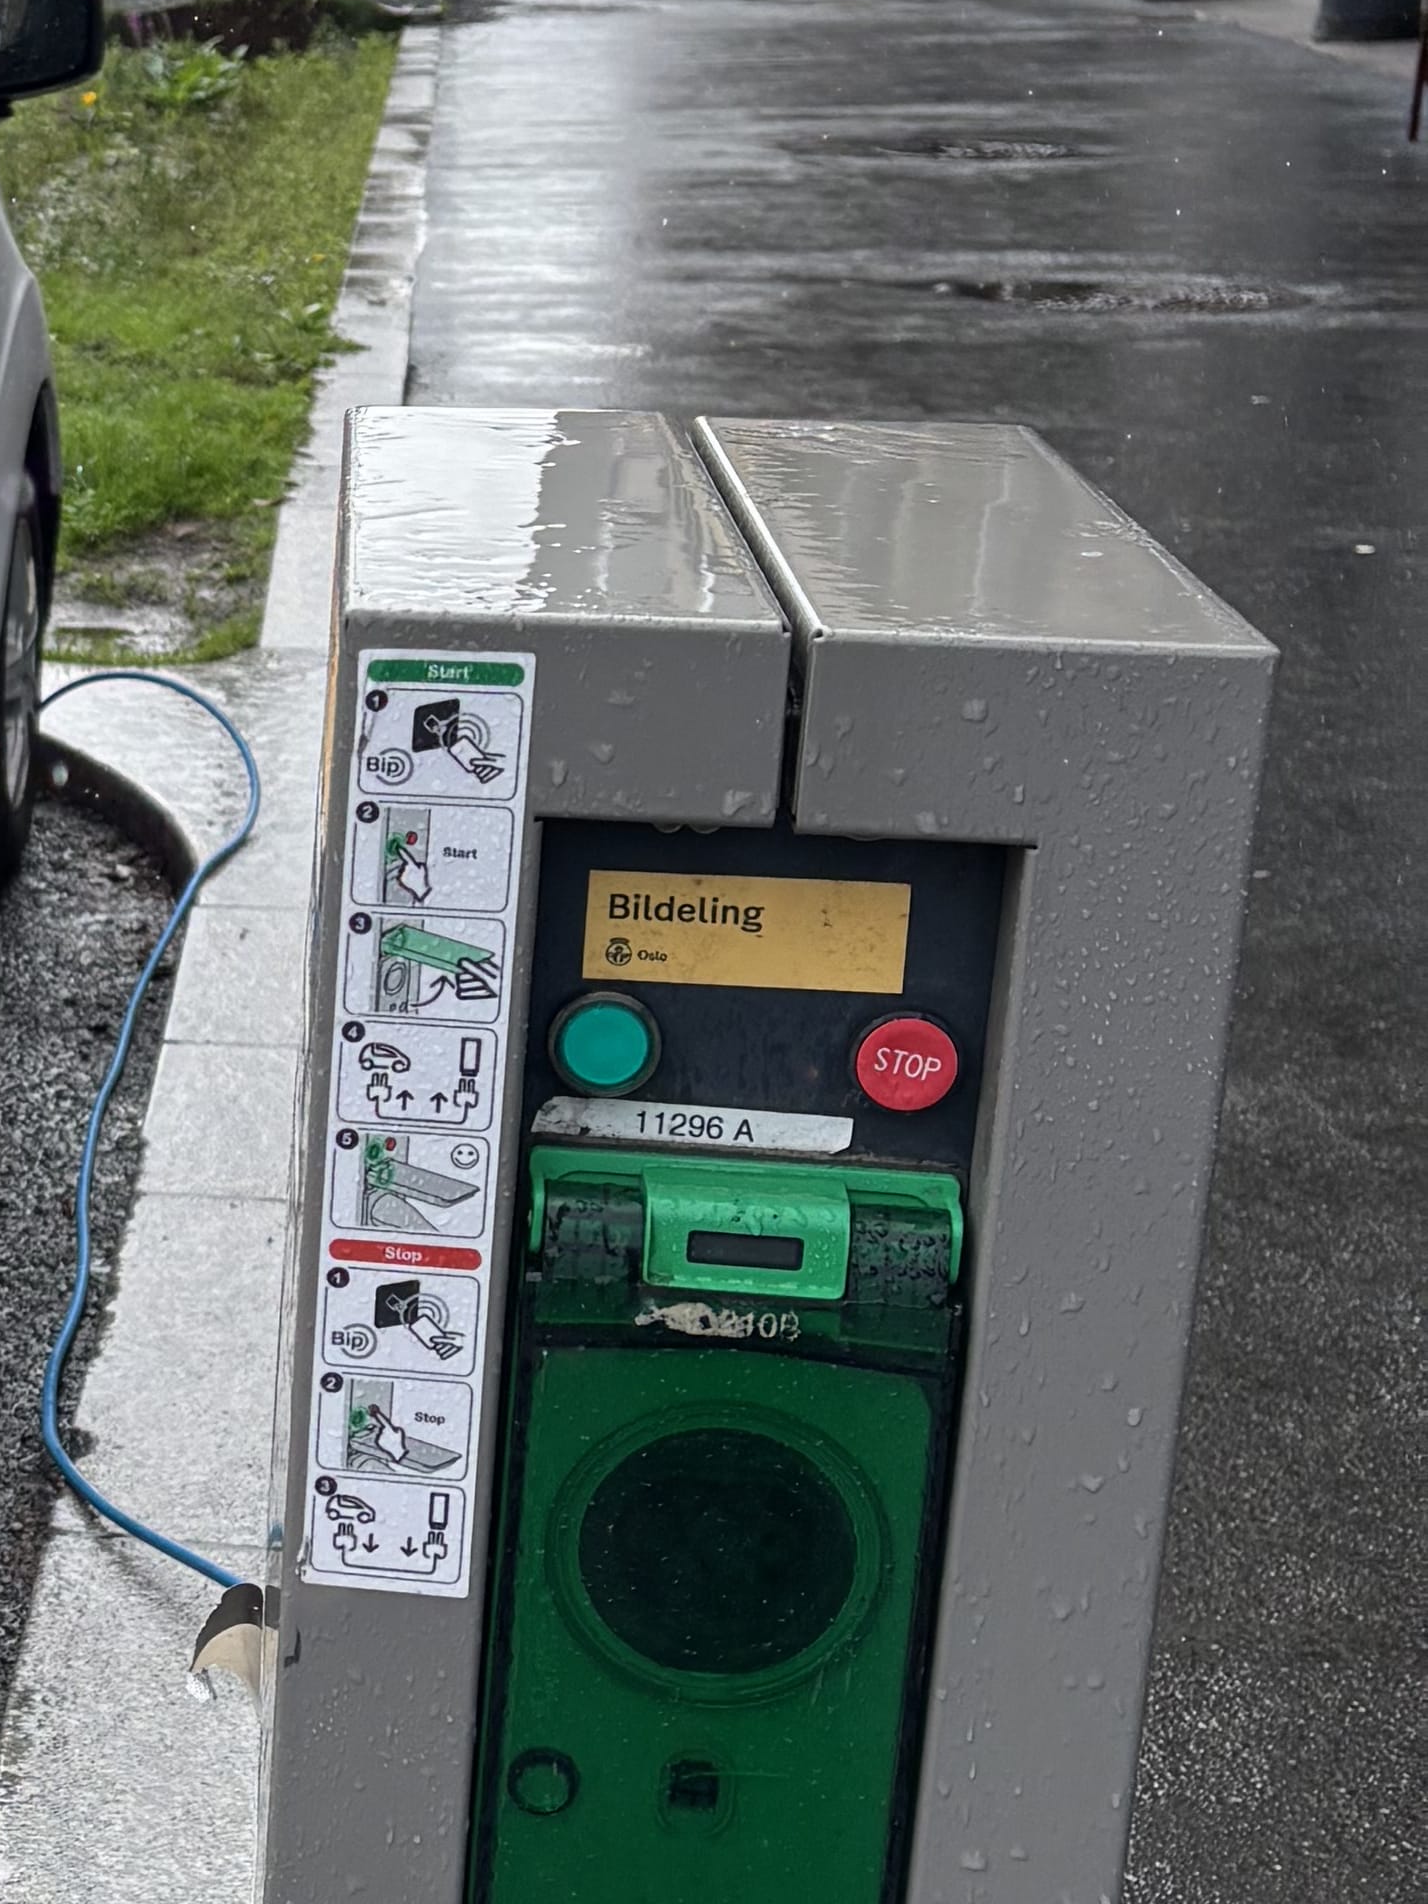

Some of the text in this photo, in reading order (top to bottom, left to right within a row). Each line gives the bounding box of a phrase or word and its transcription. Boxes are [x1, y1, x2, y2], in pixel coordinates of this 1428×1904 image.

[427, 665, 471, 679] Start
[366, 756, 399, 777] Bip
[443, 846, 478, 860] Start
[609, 893, 765, 933] Bildeling
[637, 949, 668, 962] Oslo
[874, 1047, 942, 1081] STOP
[636, 1110, 754, 1143] 11296 A
[384, 1247, 423, 1263] Stop
[331, 1332, 364, 1350] Bip
[414, 1412, 446, 1426] Stop
